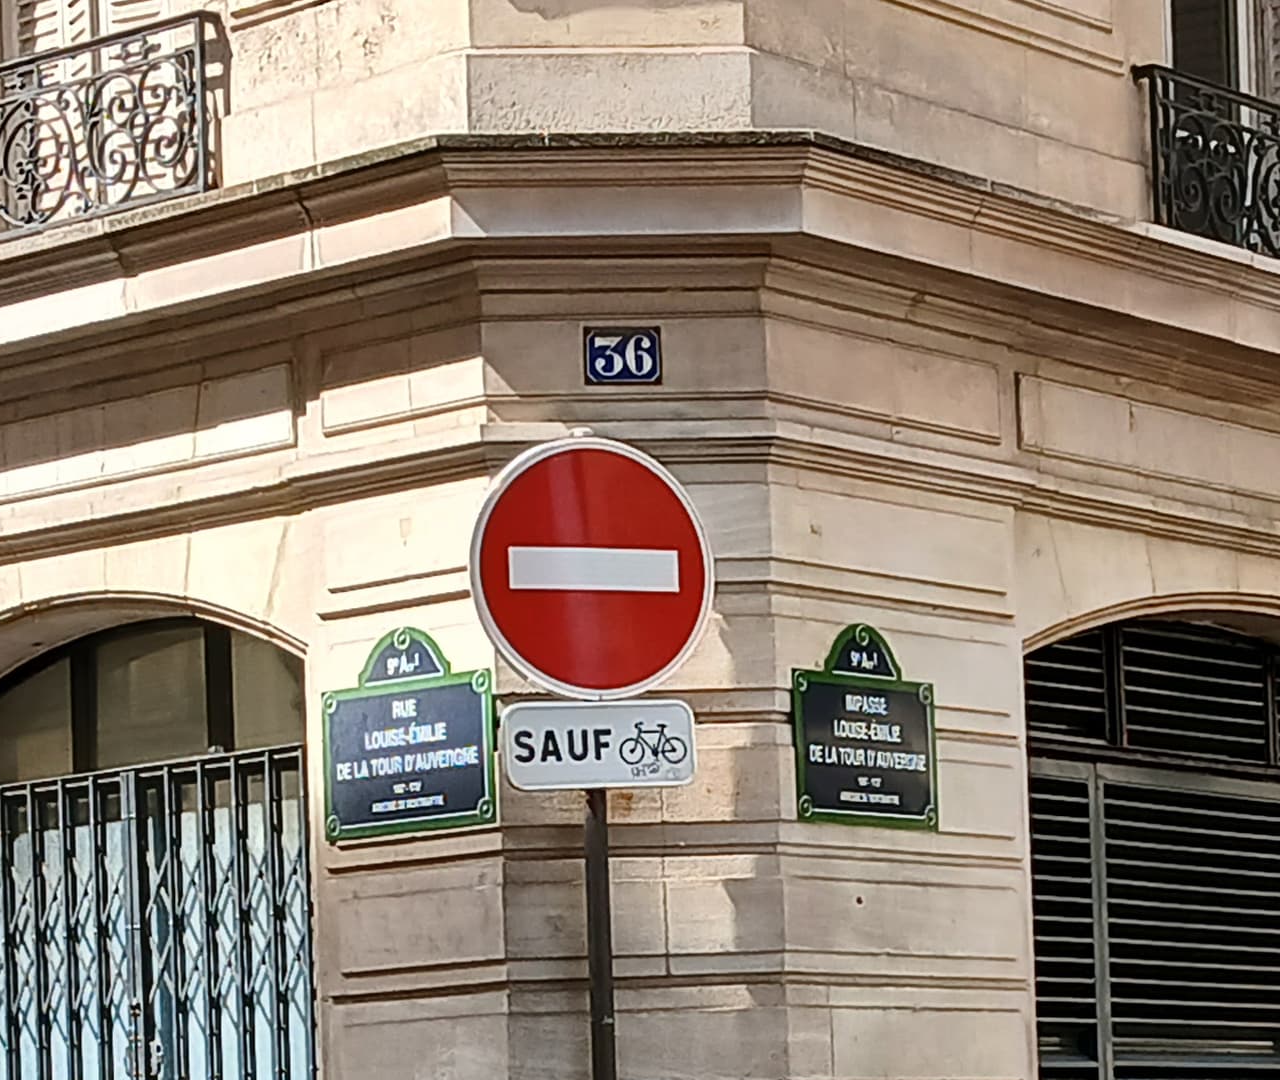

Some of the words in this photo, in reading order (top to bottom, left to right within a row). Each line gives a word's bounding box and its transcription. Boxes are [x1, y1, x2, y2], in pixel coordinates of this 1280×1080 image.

[594, 334, 653, 376] 36
[392, 698, 417, 719] RUE
[845, 694, 888, 715] IMPASSE
[514, 728, 612, 763] SAUF
[809, 744, 823, 763] DE
[825, 746, 838, 764] LA
[839, 747, 866, 766] TOUR
[336, 762, 353, 781] DE
[353, 760, 369, 779] LA
[370, 755, 403, 777] TOUR
